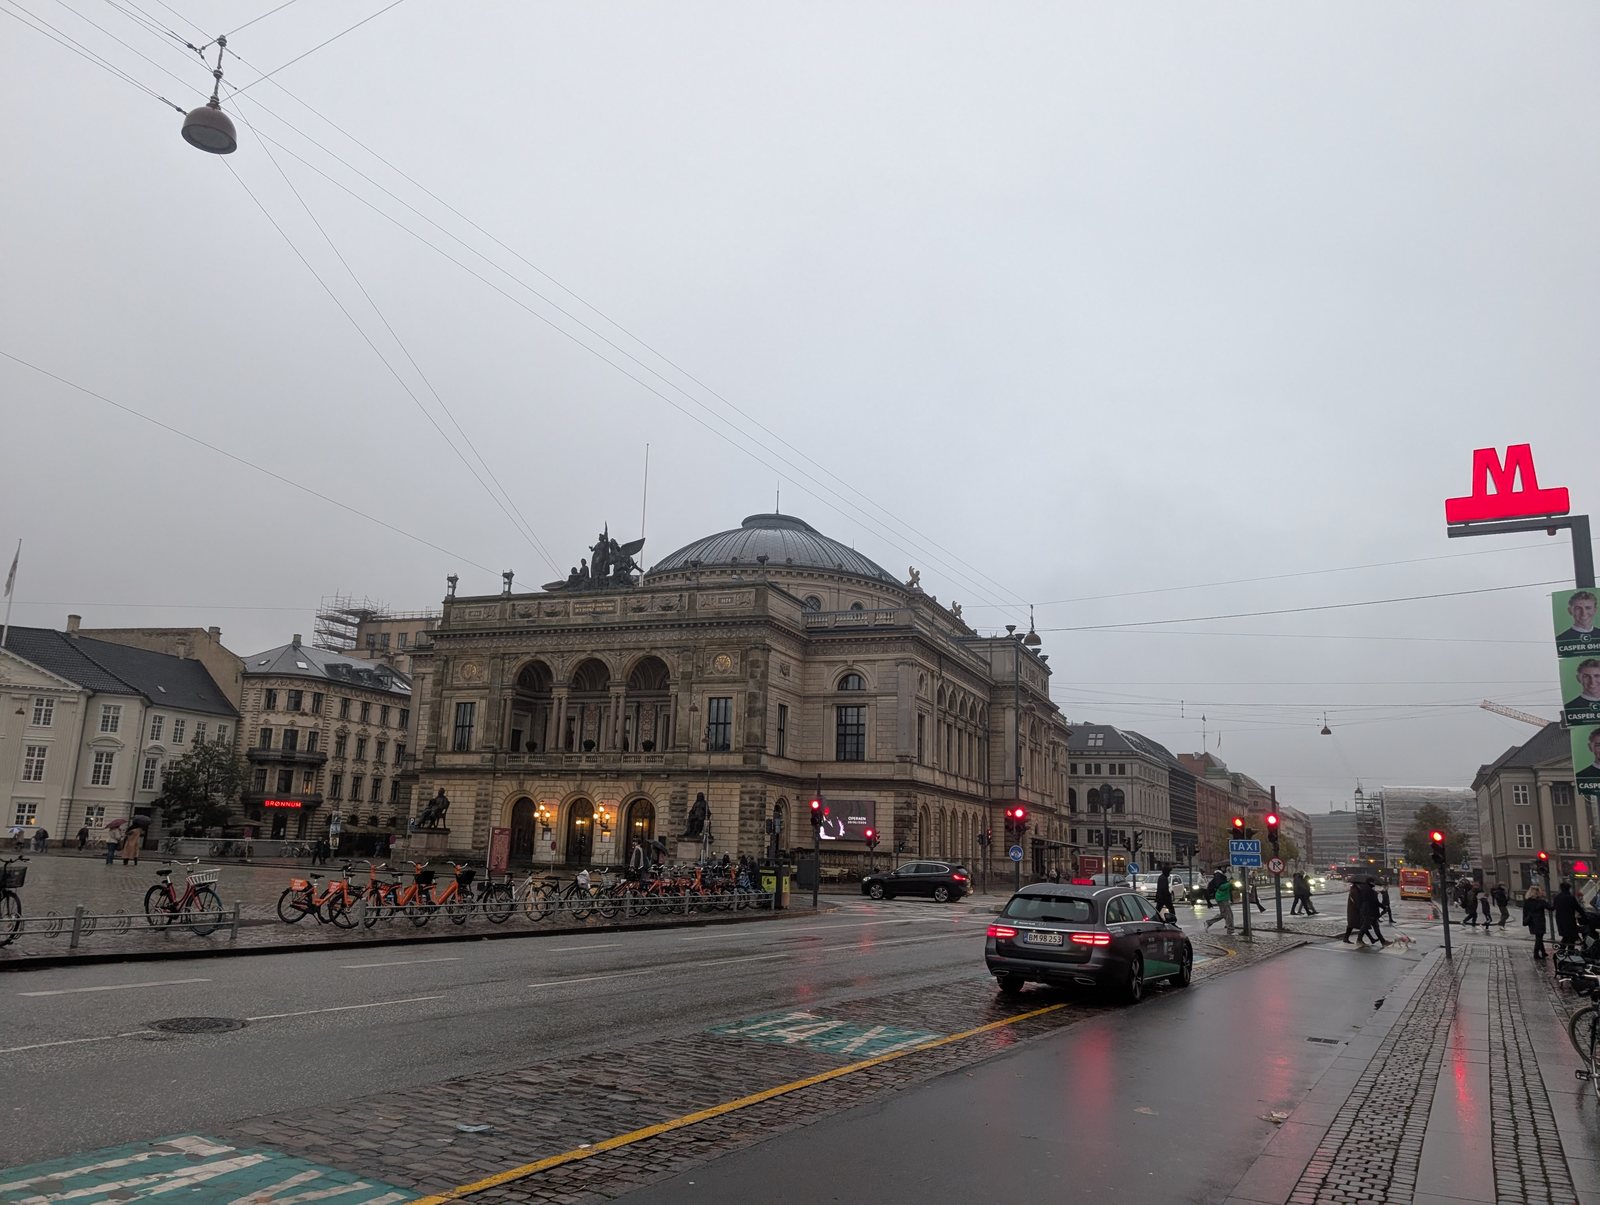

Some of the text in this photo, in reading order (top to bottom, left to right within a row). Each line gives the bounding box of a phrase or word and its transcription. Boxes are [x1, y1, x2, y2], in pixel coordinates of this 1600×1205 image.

[1558, 643, 1586, 652] CASPER
[264, 800, 302, 808] BRØNNUM
[1231, 842, 1257, 851] TAXI
[724, 1011, 942, 1056] TAXI
